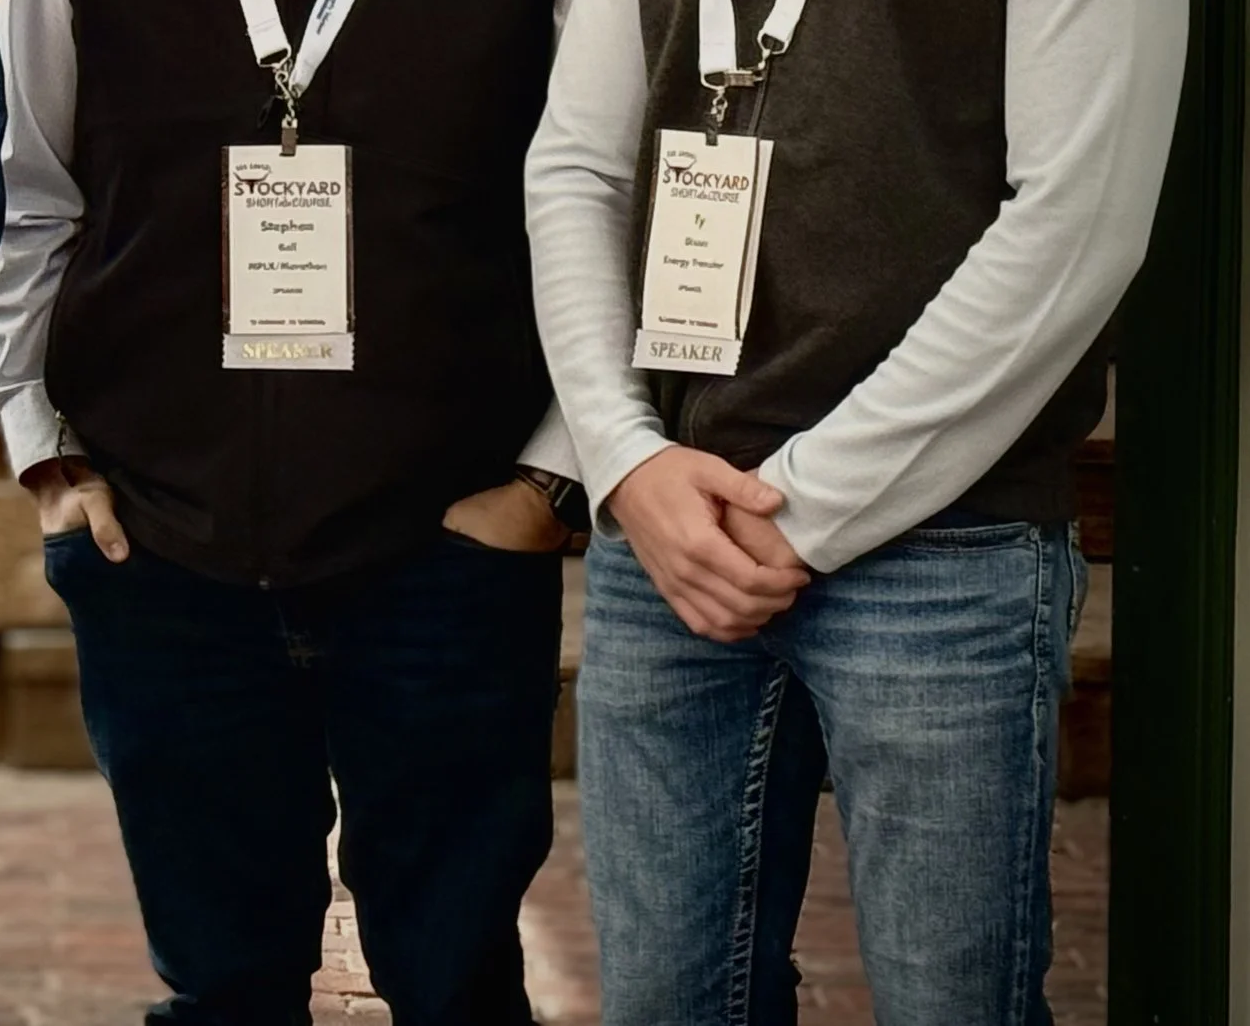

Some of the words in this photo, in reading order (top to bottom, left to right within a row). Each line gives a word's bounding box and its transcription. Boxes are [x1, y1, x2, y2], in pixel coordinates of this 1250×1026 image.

[234, 179, 341, 197] STOCKYARD
[662, 169, 749, 191] STOCKYARD
[649, 341, 723, 362] SPEAKER
